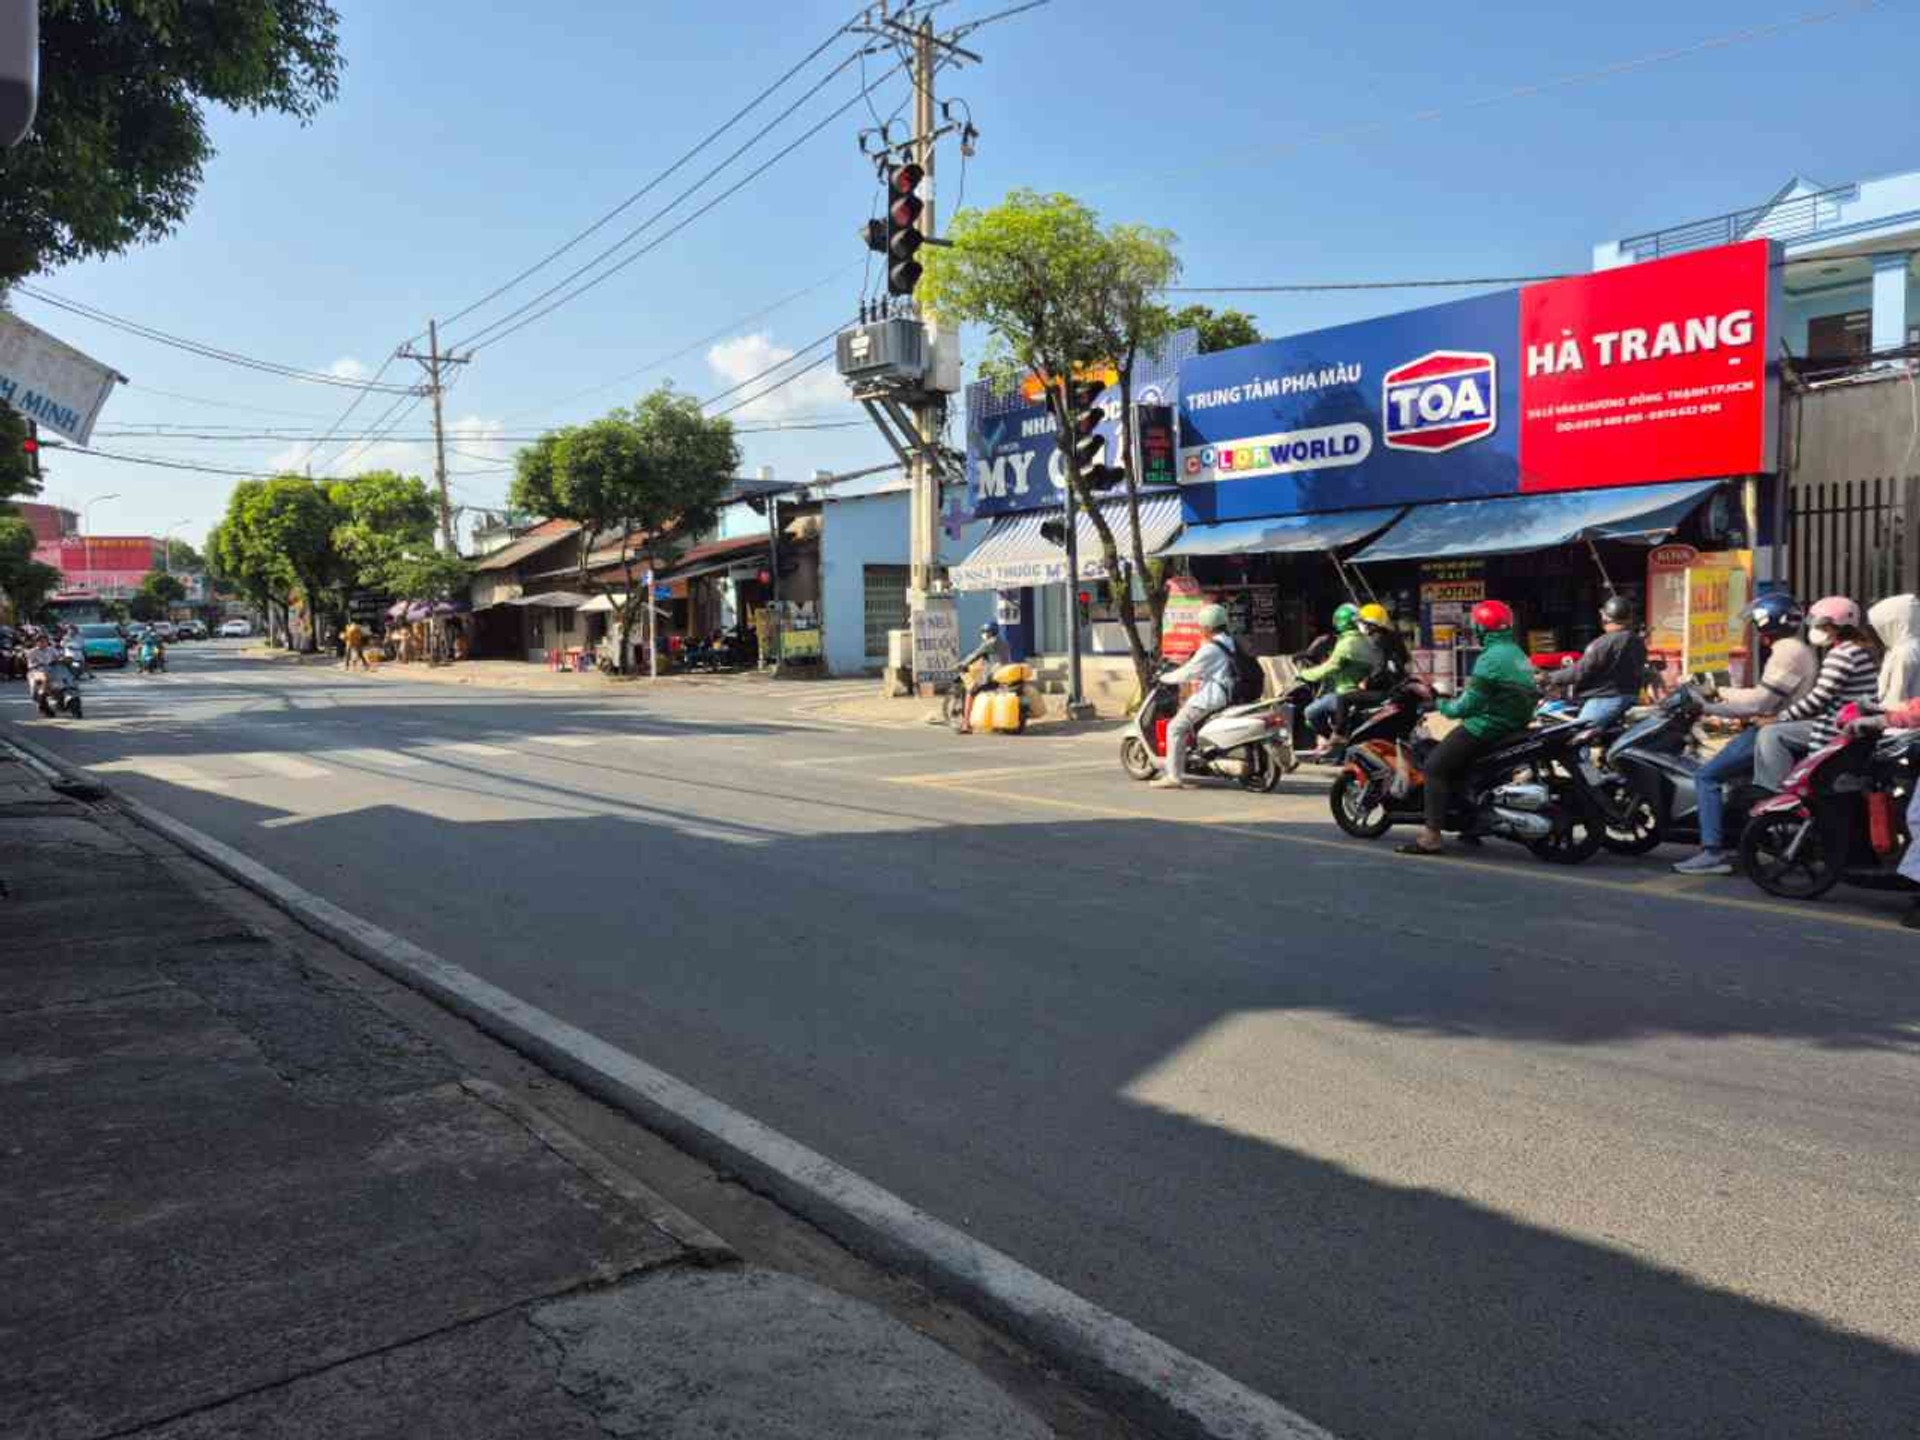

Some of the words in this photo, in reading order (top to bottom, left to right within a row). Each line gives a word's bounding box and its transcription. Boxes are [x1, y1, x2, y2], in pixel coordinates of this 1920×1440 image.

[1527, 328, 1584, 377] HÀ
[1592, 309, 1753, 367] TRANG
[18, 389, 80, 433] MINH
[1186, 386, 1242, 413] TRUNG
[1242, 376, 1280, 400] TÂM
[1281, 371, 1318, 395] PHA
[1319, 361, 1362, 388] MÀU
[1390, 378, 1486, 426] TOA
